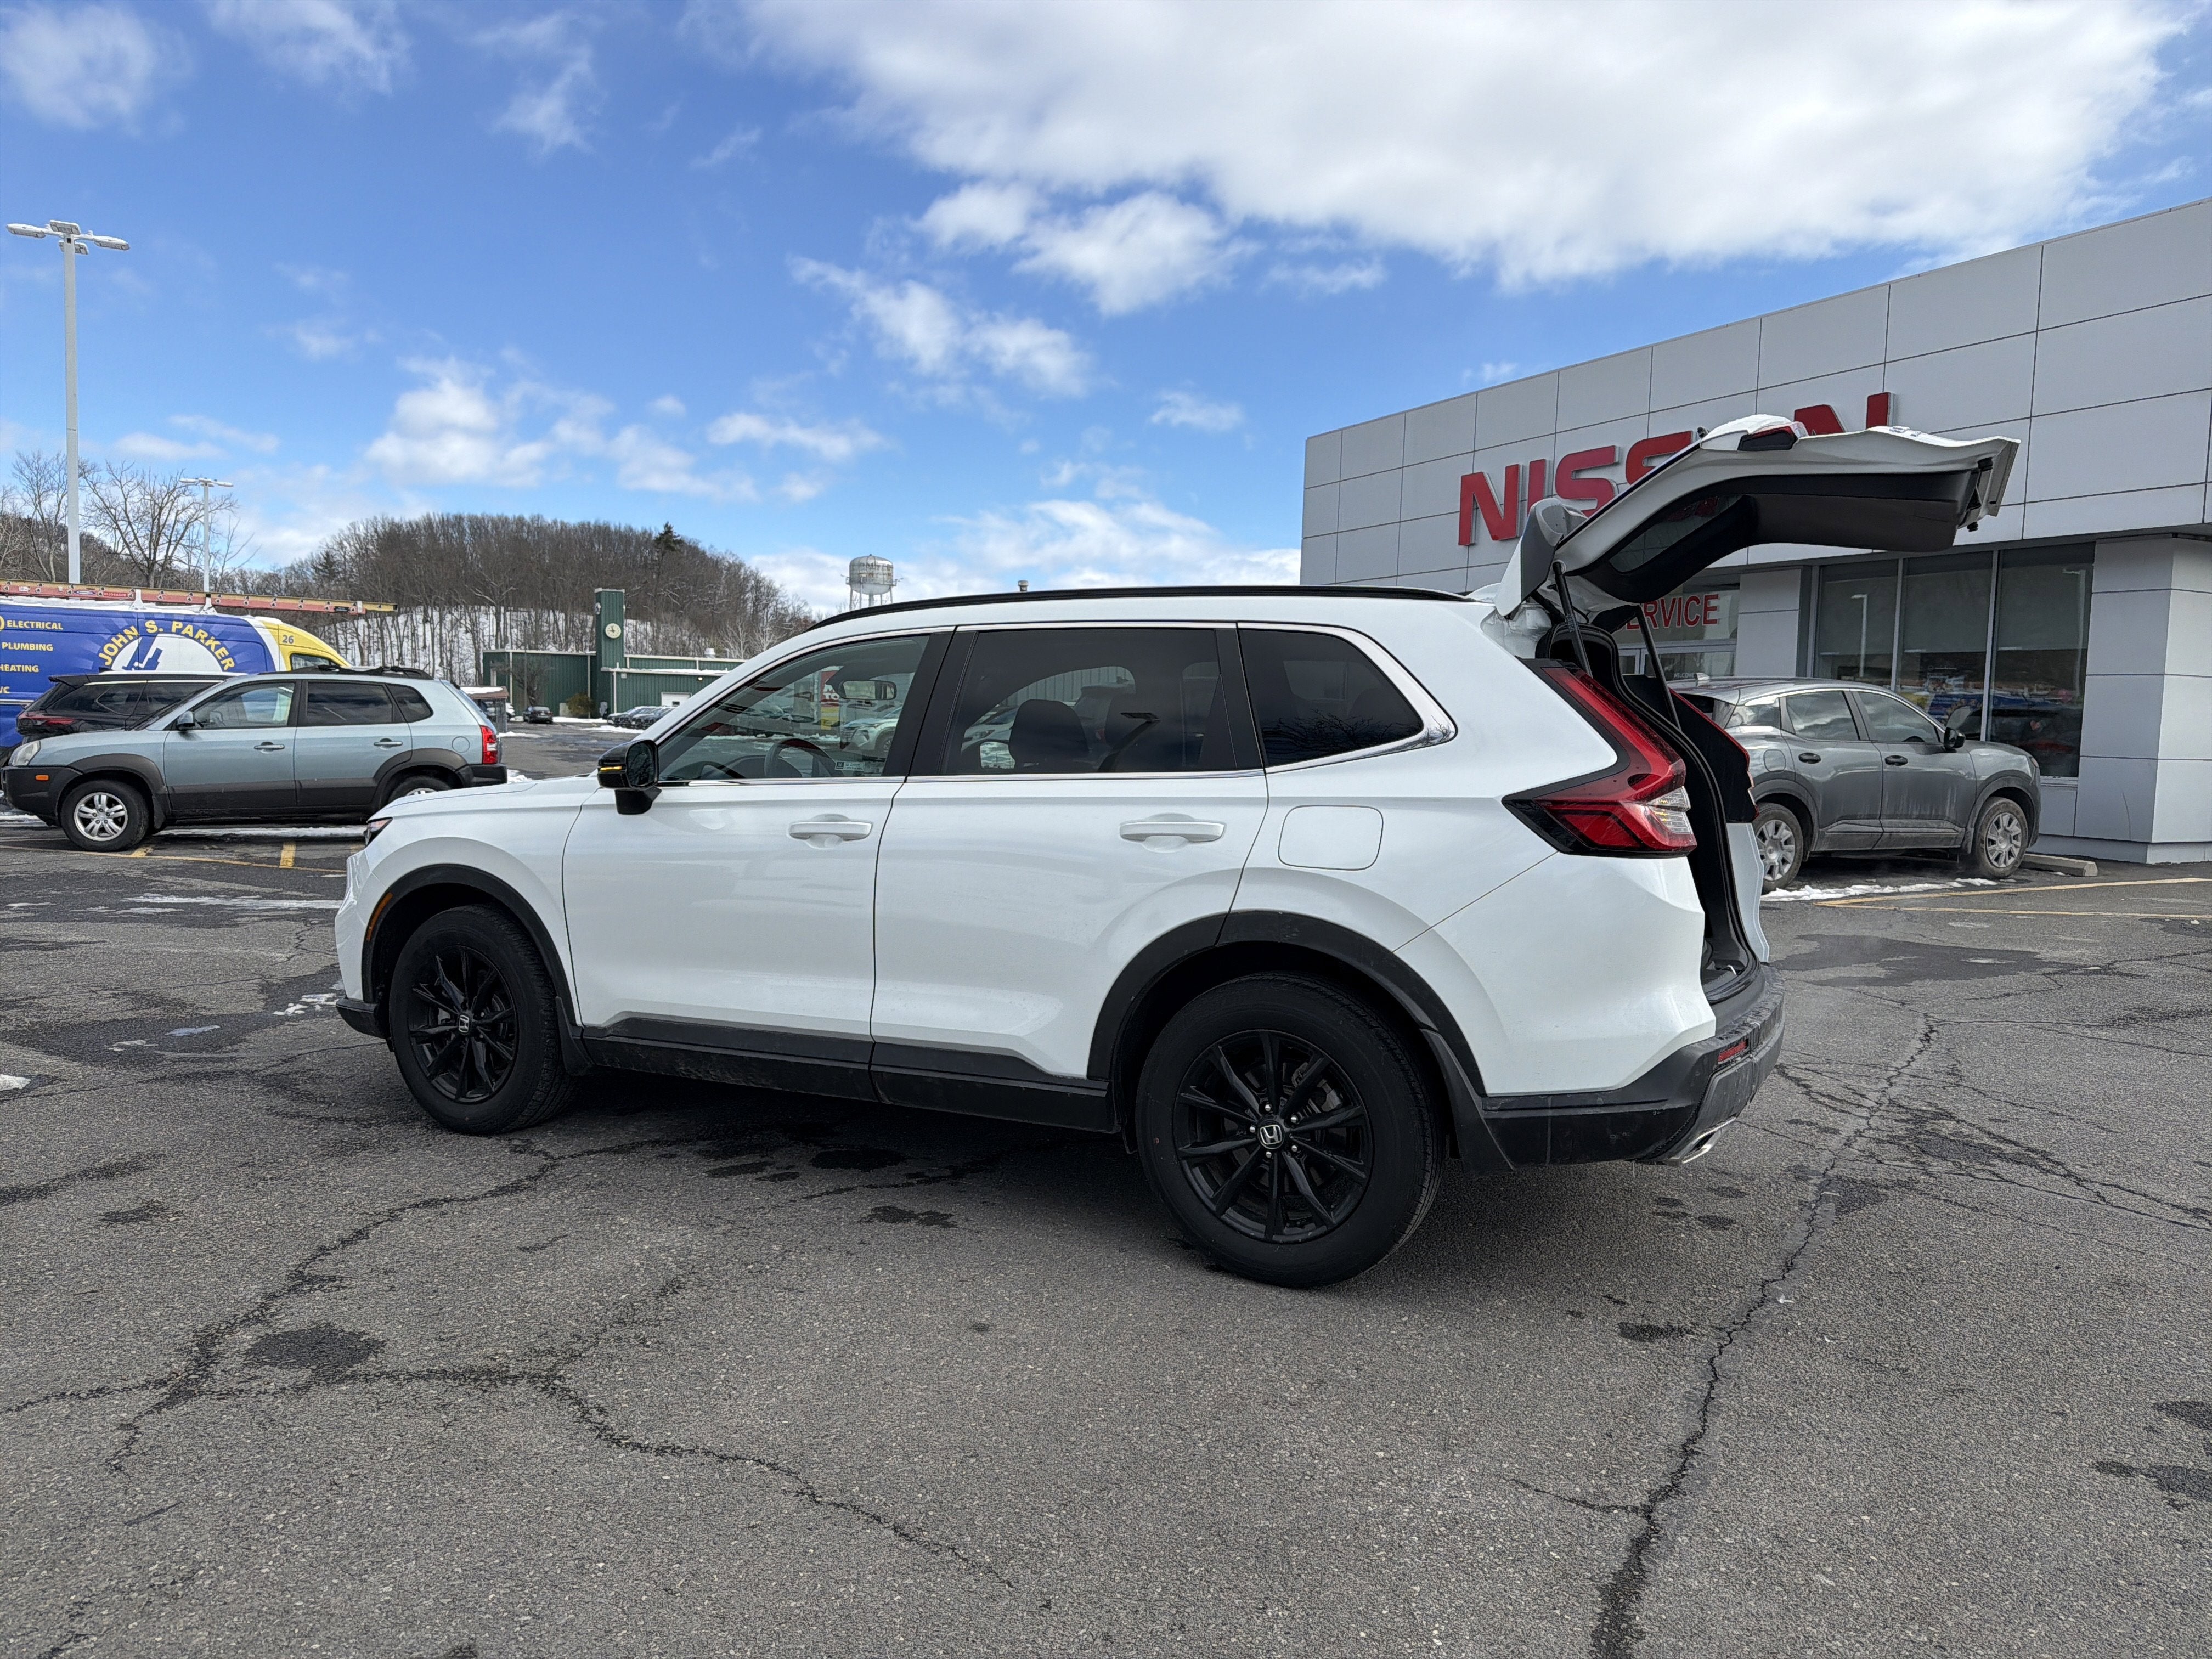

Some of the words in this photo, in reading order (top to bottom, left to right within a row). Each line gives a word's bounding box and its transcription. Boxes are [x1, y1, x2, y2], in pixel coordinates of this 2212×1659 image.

[1622, 594, 1719, 630] RVICE
[7, 620, 64, 630] ELECTRICAL
[282, 634, 294, 644] 26
[2, 642, 53, 651] PLUMBING
[98, 625, 139, 665] JOHN
[145, 620, 163, 633] S.
[171, 621, 235, 670] PARKER
